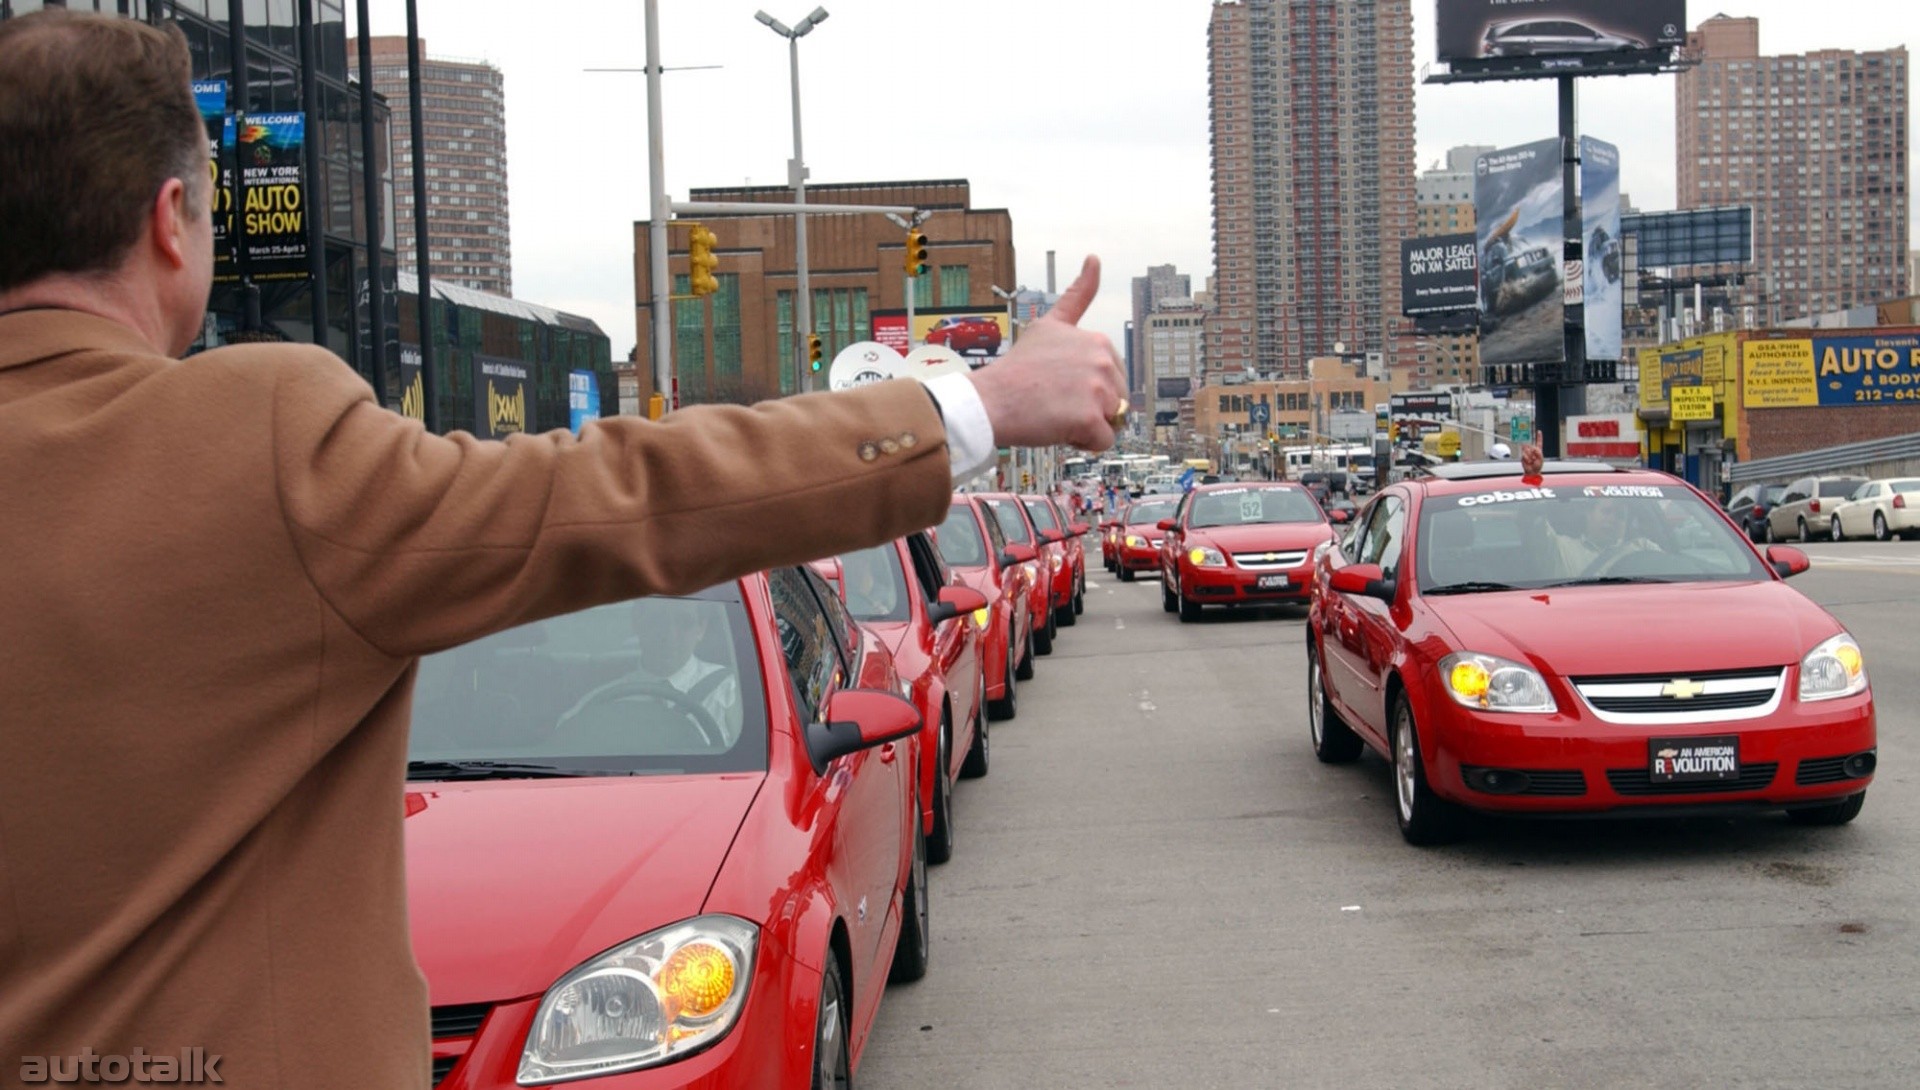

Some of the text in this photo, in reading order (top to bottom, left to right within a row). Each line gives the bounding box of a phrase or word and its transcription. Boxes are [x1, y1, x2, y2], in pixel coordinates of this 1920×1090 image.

[245, 115, 300, 125] WELCOME
[243, 166, 299, 178] NEW YORK
[244, 176, 300, 186] INTERNATIONAL
[245, 185, 300, 212] AUTO
[245, 211, 302, 234] SHOW
[249, 246, 270, 254] March
[1410, 247, 1444, 262] MAJOR
[1410, 261, 1425, 275] ON
[1428, 260, 1443, 273] XM
[1875, 338, 1919, 347] Eleventh
[1749, 351, 1809, 359] AUTHORIZED
[1820, 345, 1899, 377] AUTO
[1862, 373, 1920, 386] & BODY
[1458, 488, 1556, 506] cobalt
[1242, 501, 1260, 517] 52
[1681, 746, 1735, 757] AN AMERICAN
[1655, 757, 1735, 774] REVOLUTION
